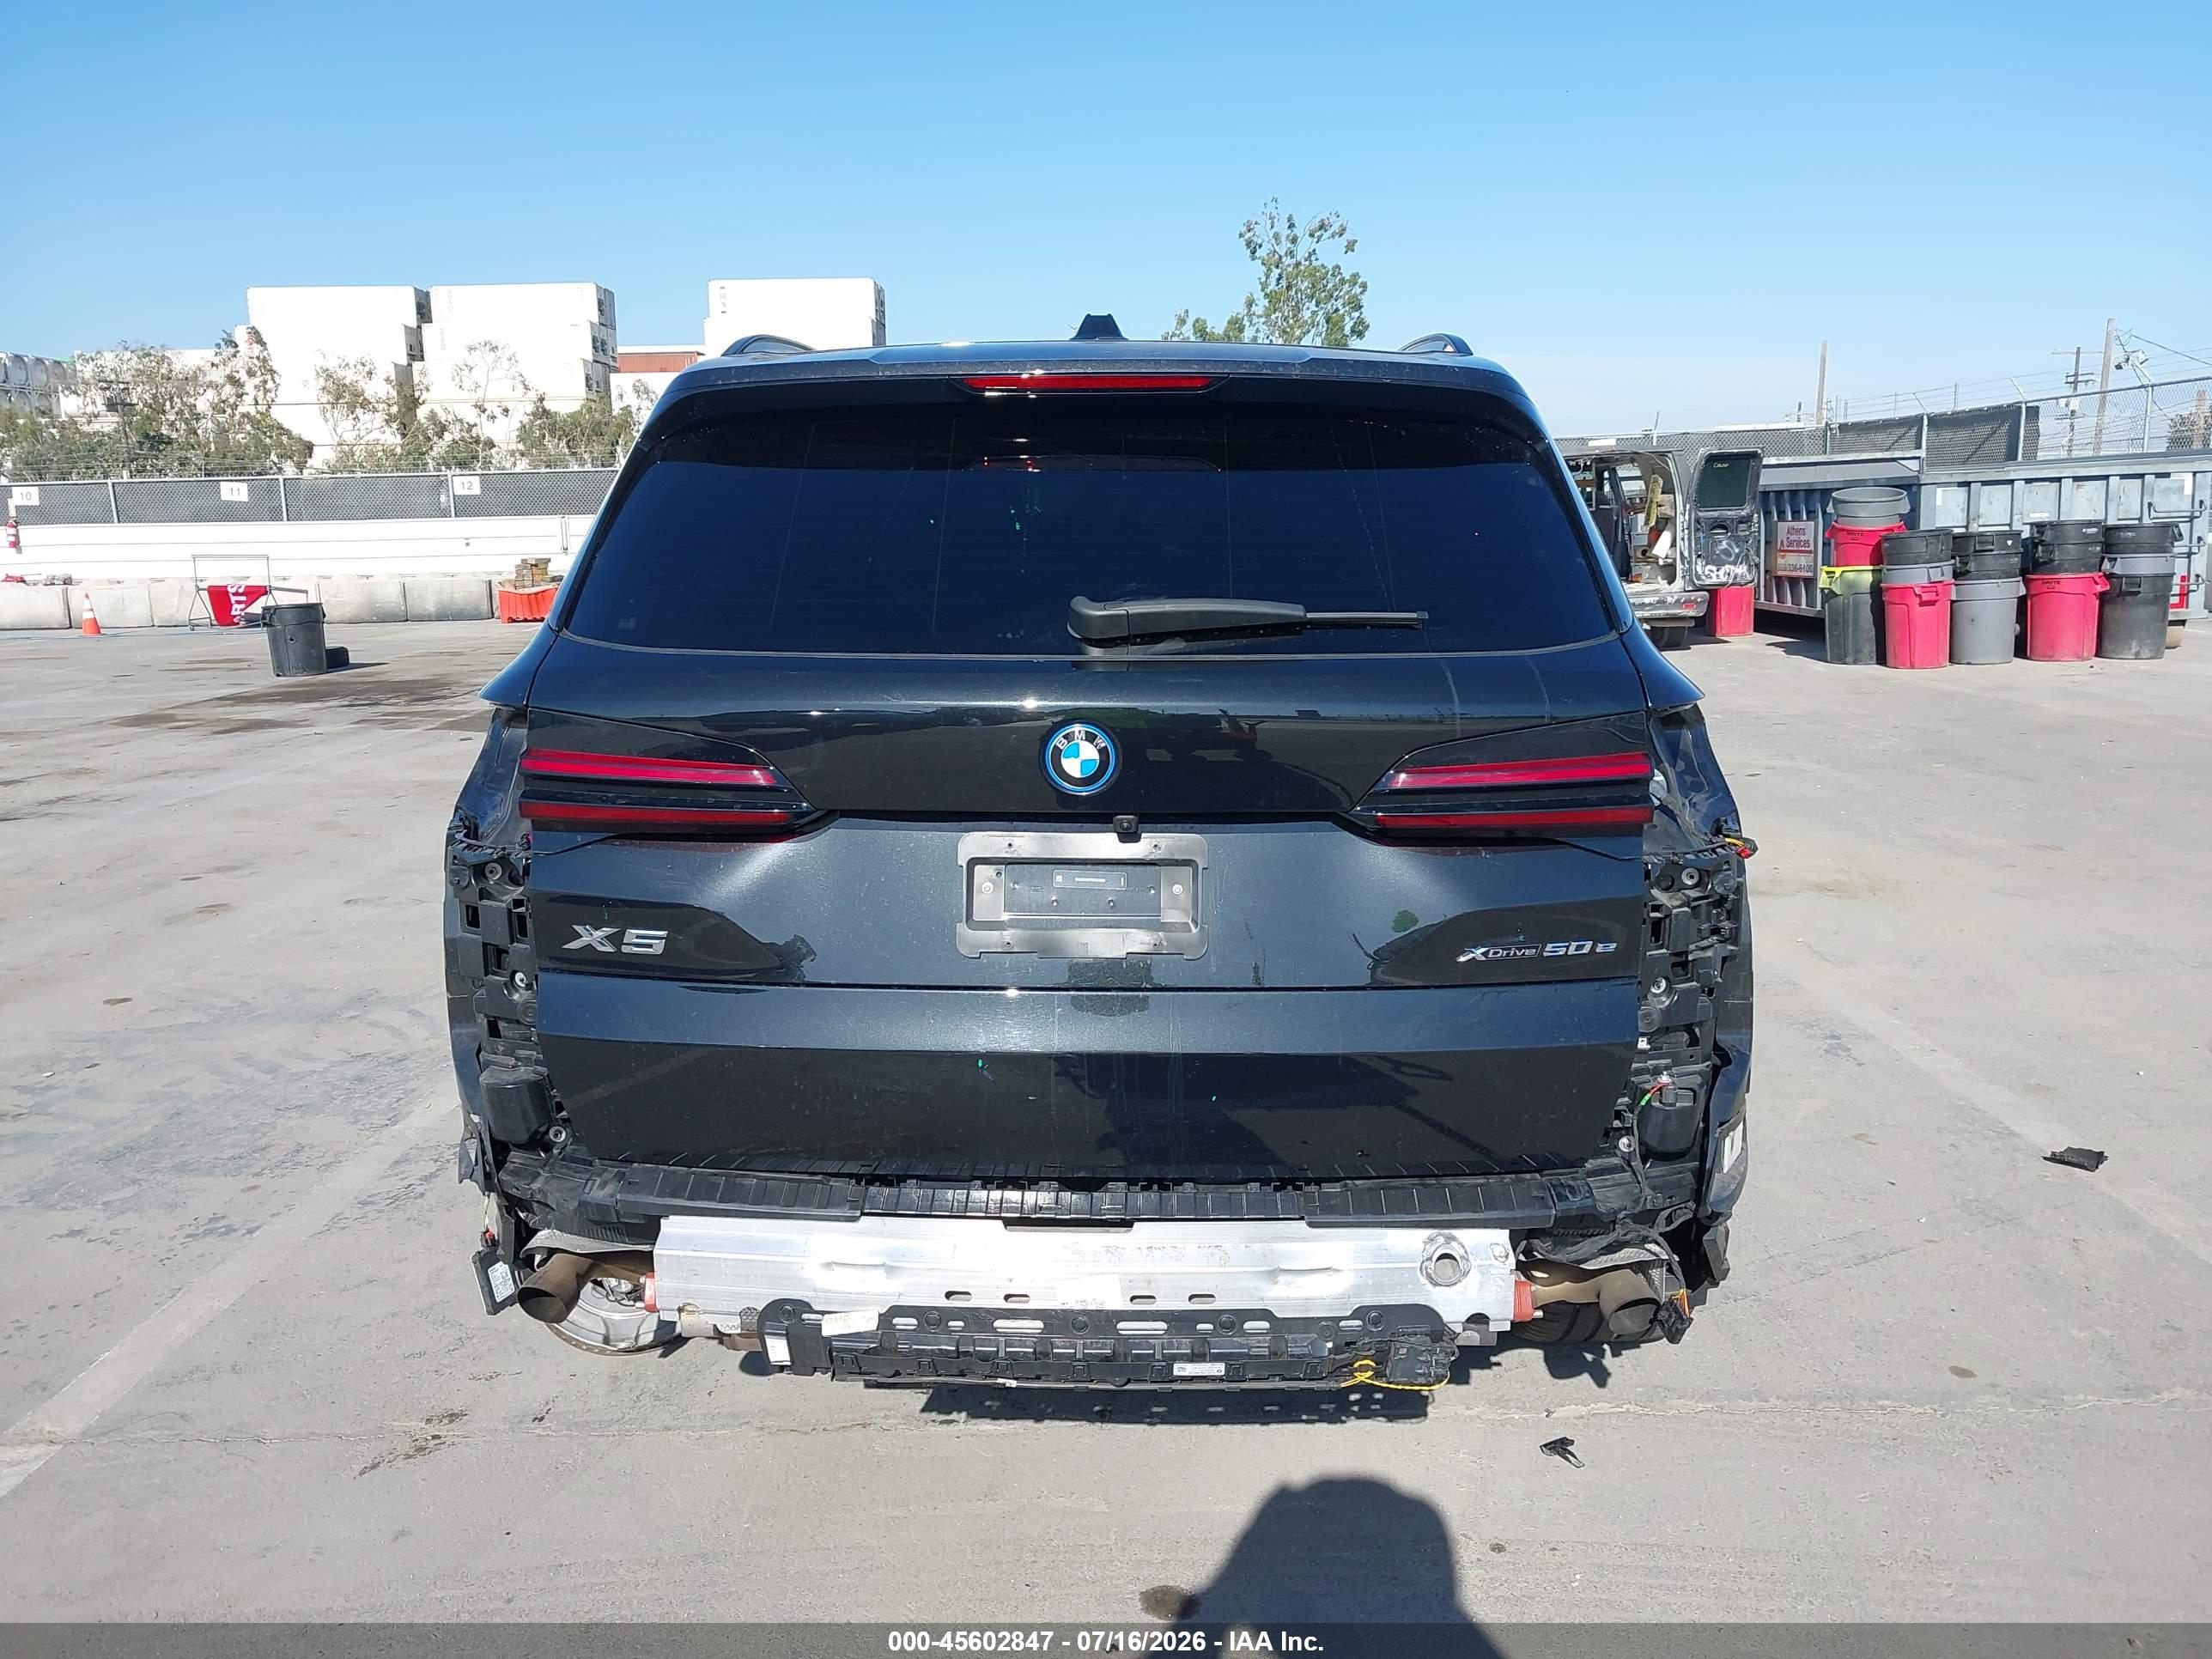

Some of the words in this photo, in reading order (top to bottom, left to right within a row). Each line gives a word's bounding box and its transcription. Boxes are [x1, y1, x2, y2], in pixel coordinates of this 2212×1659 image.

[461, 481, 474, 490] 12
[20, 491, 32, 501] 10
[230, 487, 240, 496] 11
[1786, 526, 1806, 536] Athens
[1786, 537, 1810, 549] Services
[1055, 728, 1106, 750] BMW
[561, 924, 669, 955] X5
